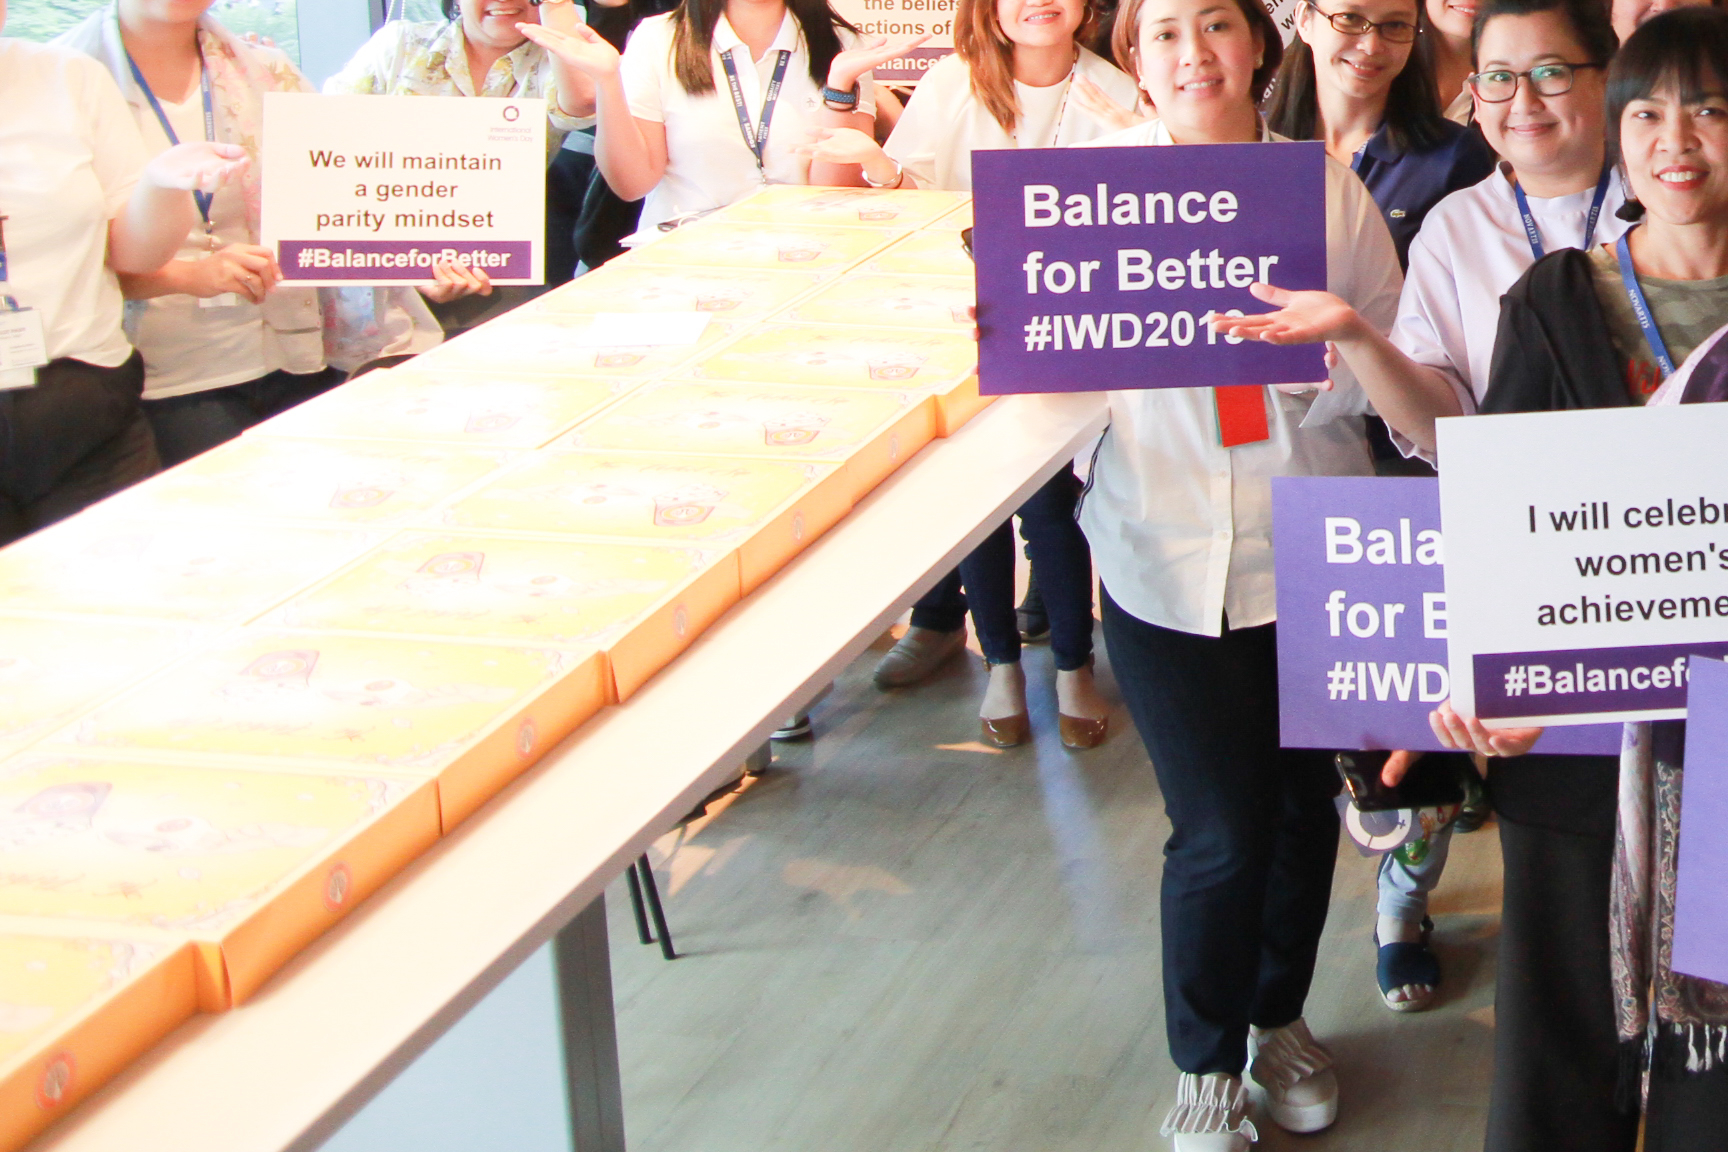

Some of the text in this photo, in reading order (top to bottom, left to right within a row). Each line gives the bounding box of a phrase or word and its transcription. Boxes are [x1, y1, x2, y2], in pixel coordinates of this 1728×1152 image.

[853, 19, 952, 36] actions of
[743, 122, 756, 149] SANDOZ
[309, 150, 502, 171] We will maintain
[355, 181, 458, 202] a gender
[1023, 183, 1239, 228] Balance
[316, 210, 494, 232] parity mindset
[1523, 213, 1539, 245] NOVARTIS
[1022, 248, 1279, 294] for Better
[1628, 289, 1651, 329] NOVARTIS
[1529, 505, 1536, 533] I
[1549, 503, 1609, 532] will
[1325, 590, 1405, 638] for
